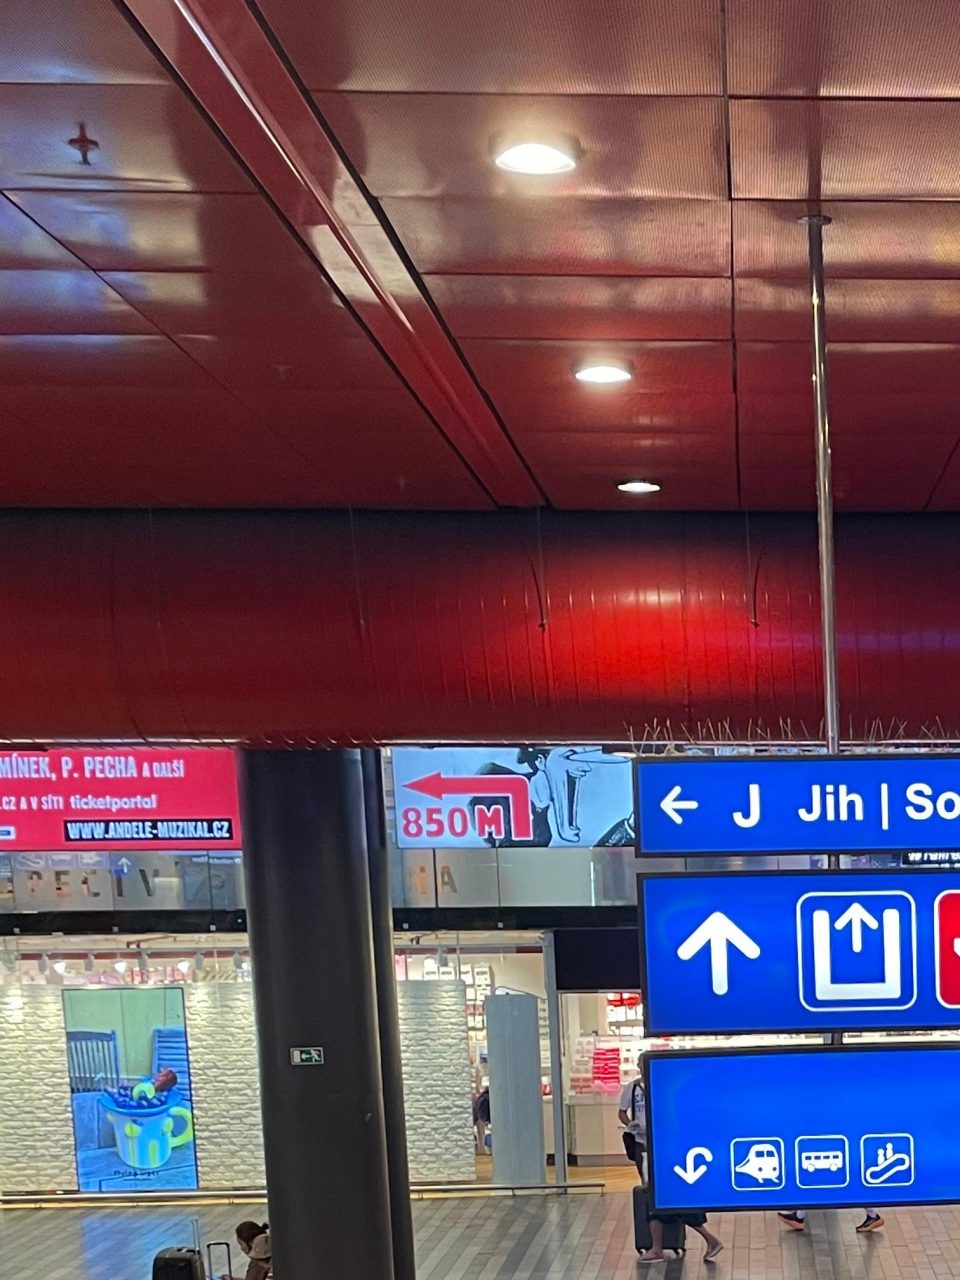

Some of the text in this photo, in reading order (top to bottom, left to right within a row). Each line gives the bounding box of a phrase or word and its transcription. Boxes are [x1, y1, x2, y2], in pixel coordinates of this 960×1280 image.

[61, 756, 79, 779] P.
[83, 755, 137, 778] PECHA
[142, 762, 152, 778] A
[20, 796, 28, 810] A
[30, 796, 38, 810] V
[41, 793, 64, 810] SÍTI
[69, 793, 158, 812] ticketportal
[732, 783, 760, 828] J
[798, 784, 864, 822] Jih
[67, 820, 231, 840] WWW.ANDELE-MUZIKAL.CZ
[402, 805, 505, 839] 850 M
